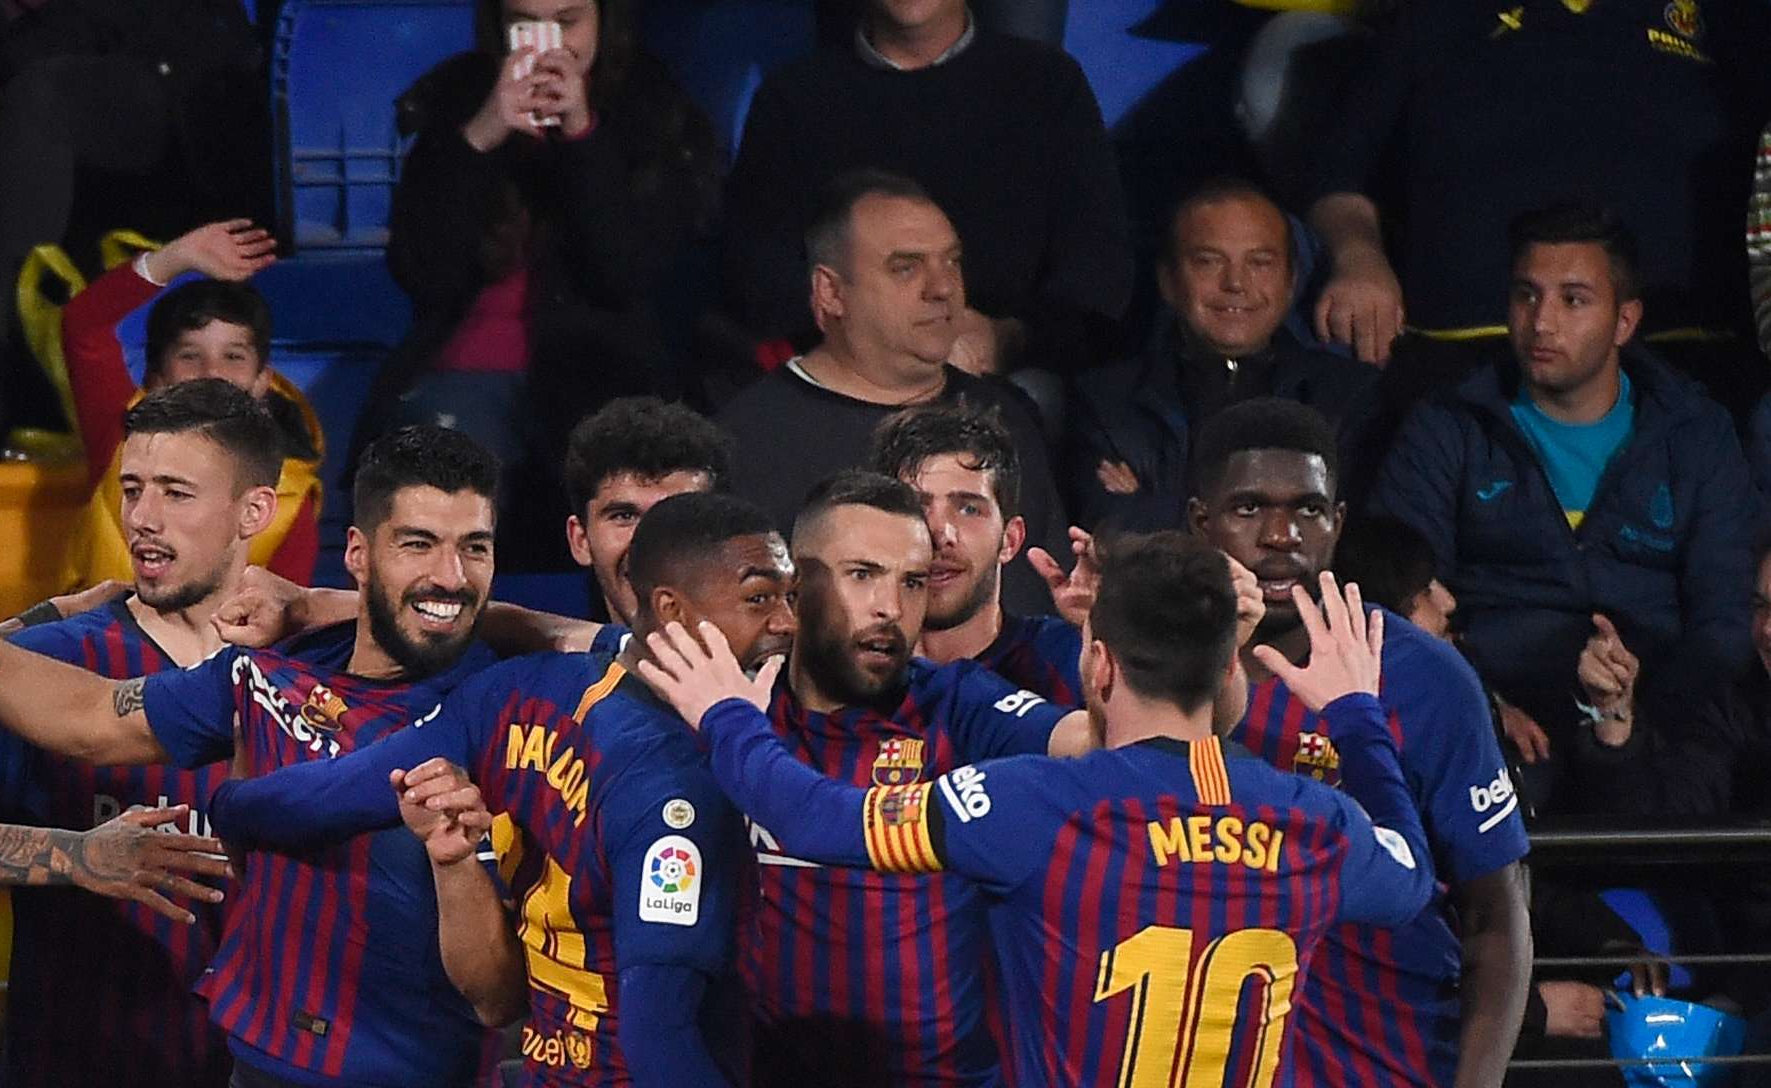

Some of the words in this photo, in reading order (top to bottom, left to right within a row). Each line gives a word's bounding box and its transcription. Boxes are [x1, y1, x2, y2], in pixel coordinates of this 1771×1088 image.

[952, 763, 992, 819] eko
[1147, 814, 1285, 873] MESSI
[645, 896, 693, 914] LaLiga
